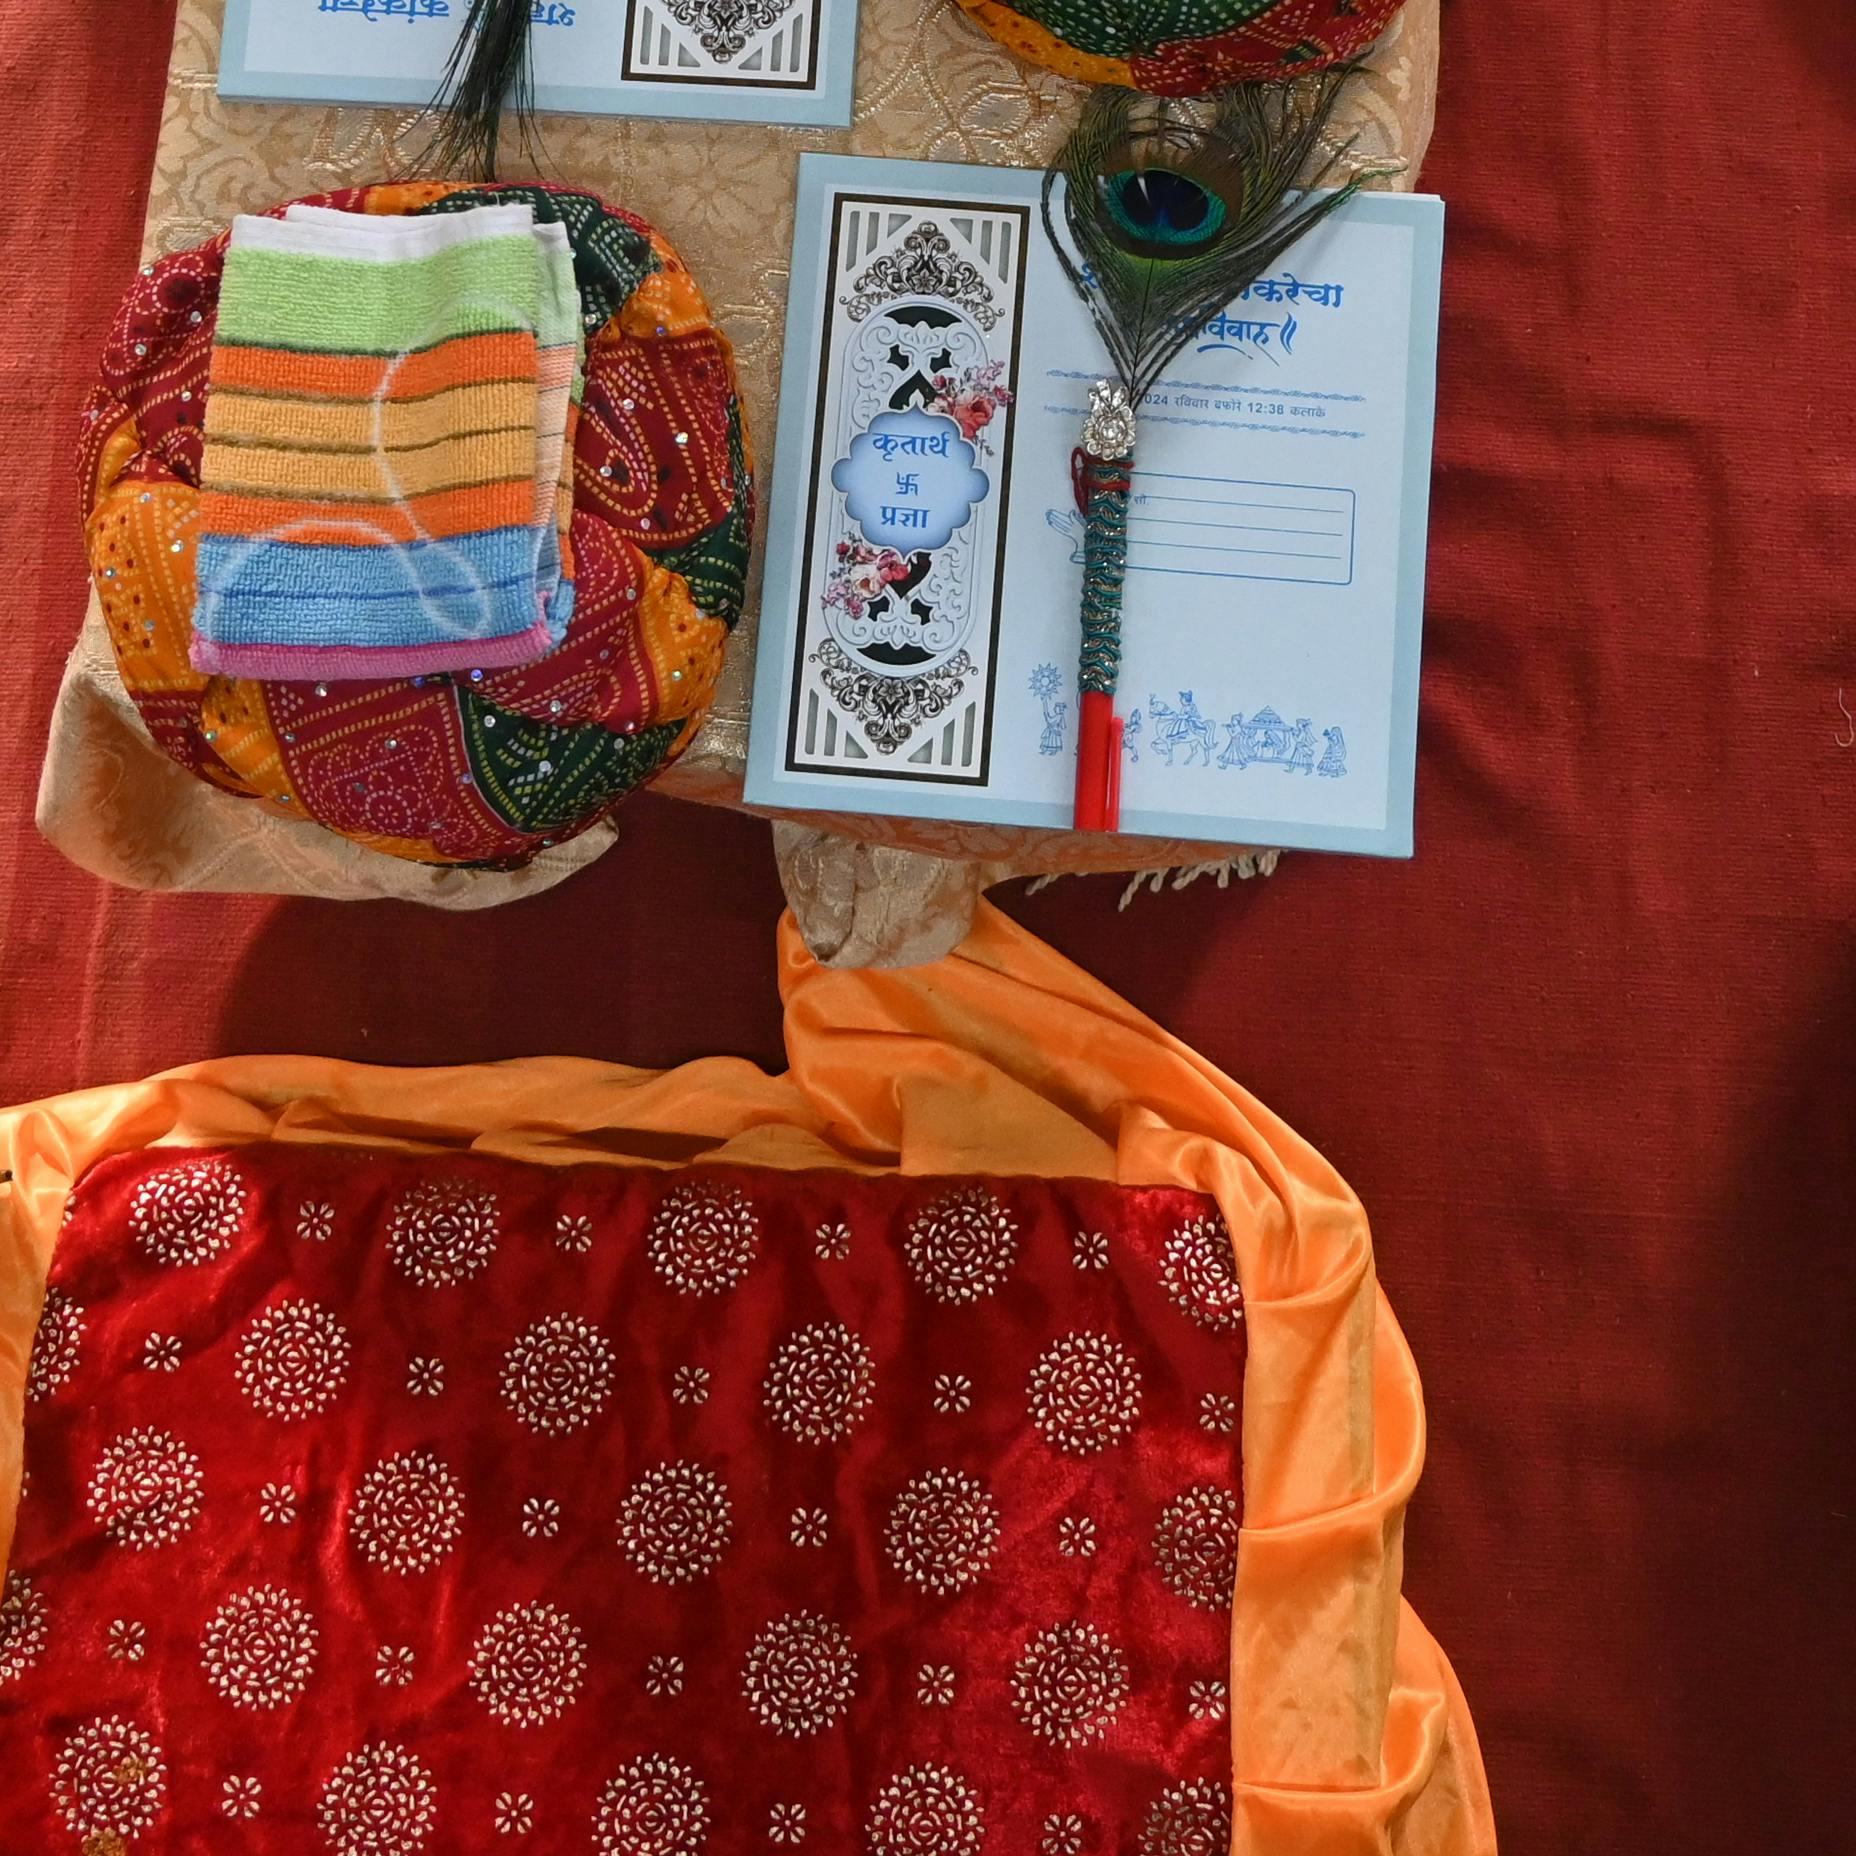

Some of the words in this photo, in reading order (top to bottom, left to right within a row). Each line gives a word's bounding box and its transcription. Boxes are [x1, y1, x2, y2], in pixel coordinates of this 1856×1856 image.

[1143, 394, 1168, 406] 024
[1247, 402, 1284, 416] 12:38
[872, 431, 951, 462] कृतार्थ
[879, 505, 932, 528] प्रज्ञा
